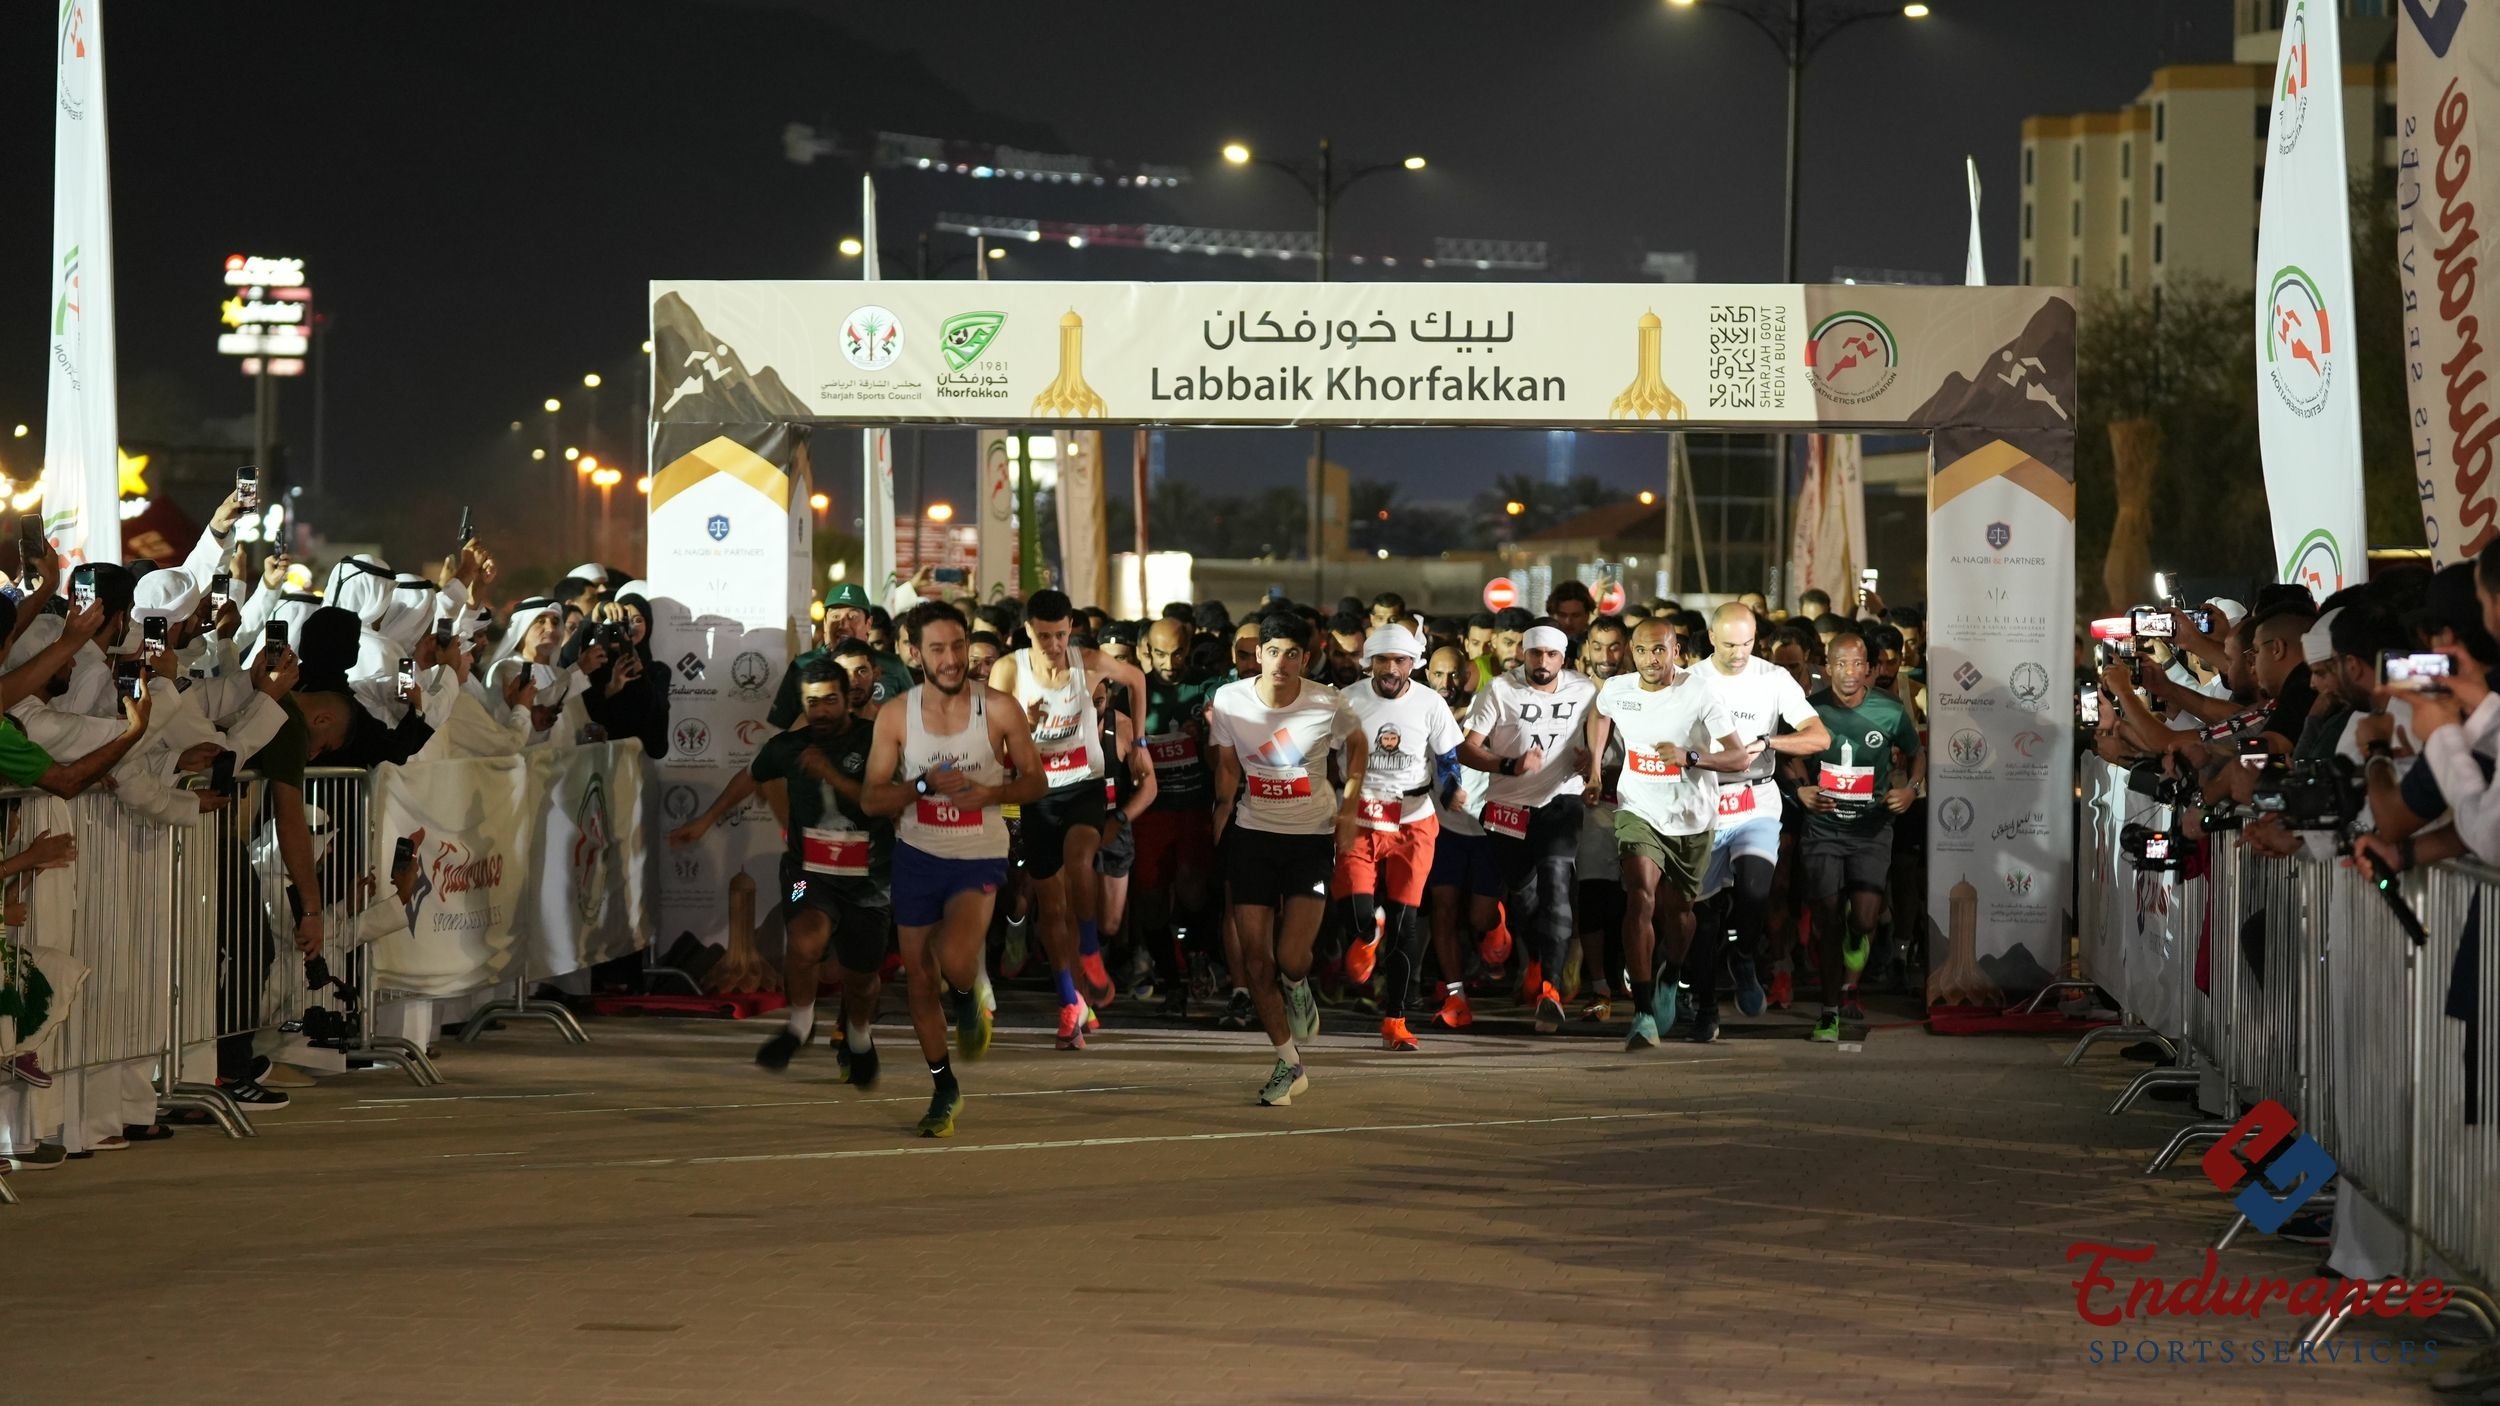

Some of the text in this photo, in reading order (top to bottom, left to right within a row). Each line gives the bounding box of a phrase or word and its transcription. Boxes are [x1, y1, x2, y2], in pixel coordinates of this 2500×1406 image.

[1203, 310, 1514, 354] لبيك خورفكان
[1760, 306, 1771, 408] SHARJAH GOVT
[1774, 306, 1786, 408] MEDIA BUREAU
[980, 361, 1008, 371] 1981
[821, 379, 856, 389] الرياضي
[858, 379, 890, 389] الشارقة
[1151, 365, 1566, 401] Labbaik Khorfakkan
[1816, 388, 1855, 405] ATHLETICS
[1857, 372, 1897, 405] FEDERATION
[821, 392, 922, 400] Sharjah Sports Council
[937, 387, 1008, 398] Khorfakkan
[1950, 556, 1961, 564] AL
[1963, 556, 1991, 565] NAQBI
[2003, 557, 2046, 566] PARTNERS
[1939, 693, 1996, 706] Endurance
[1731, 710, 1756, 720] ARK
[1157, 744, 1184, 758] 153
[1637, 758, 1666, 773] 266
[1262, 783, 1293, 796] 251
[1836, 777, 1856, 790] 37
[1364, 803, 1384, 818] 42
[1720, 797, 1739, 811] 19
[936, 806, 960, 822] 50
[1494, 808, 1519, 825] 176
[828, 846, 842, 861] 7
[432, 840, 503, 903] Endurance
